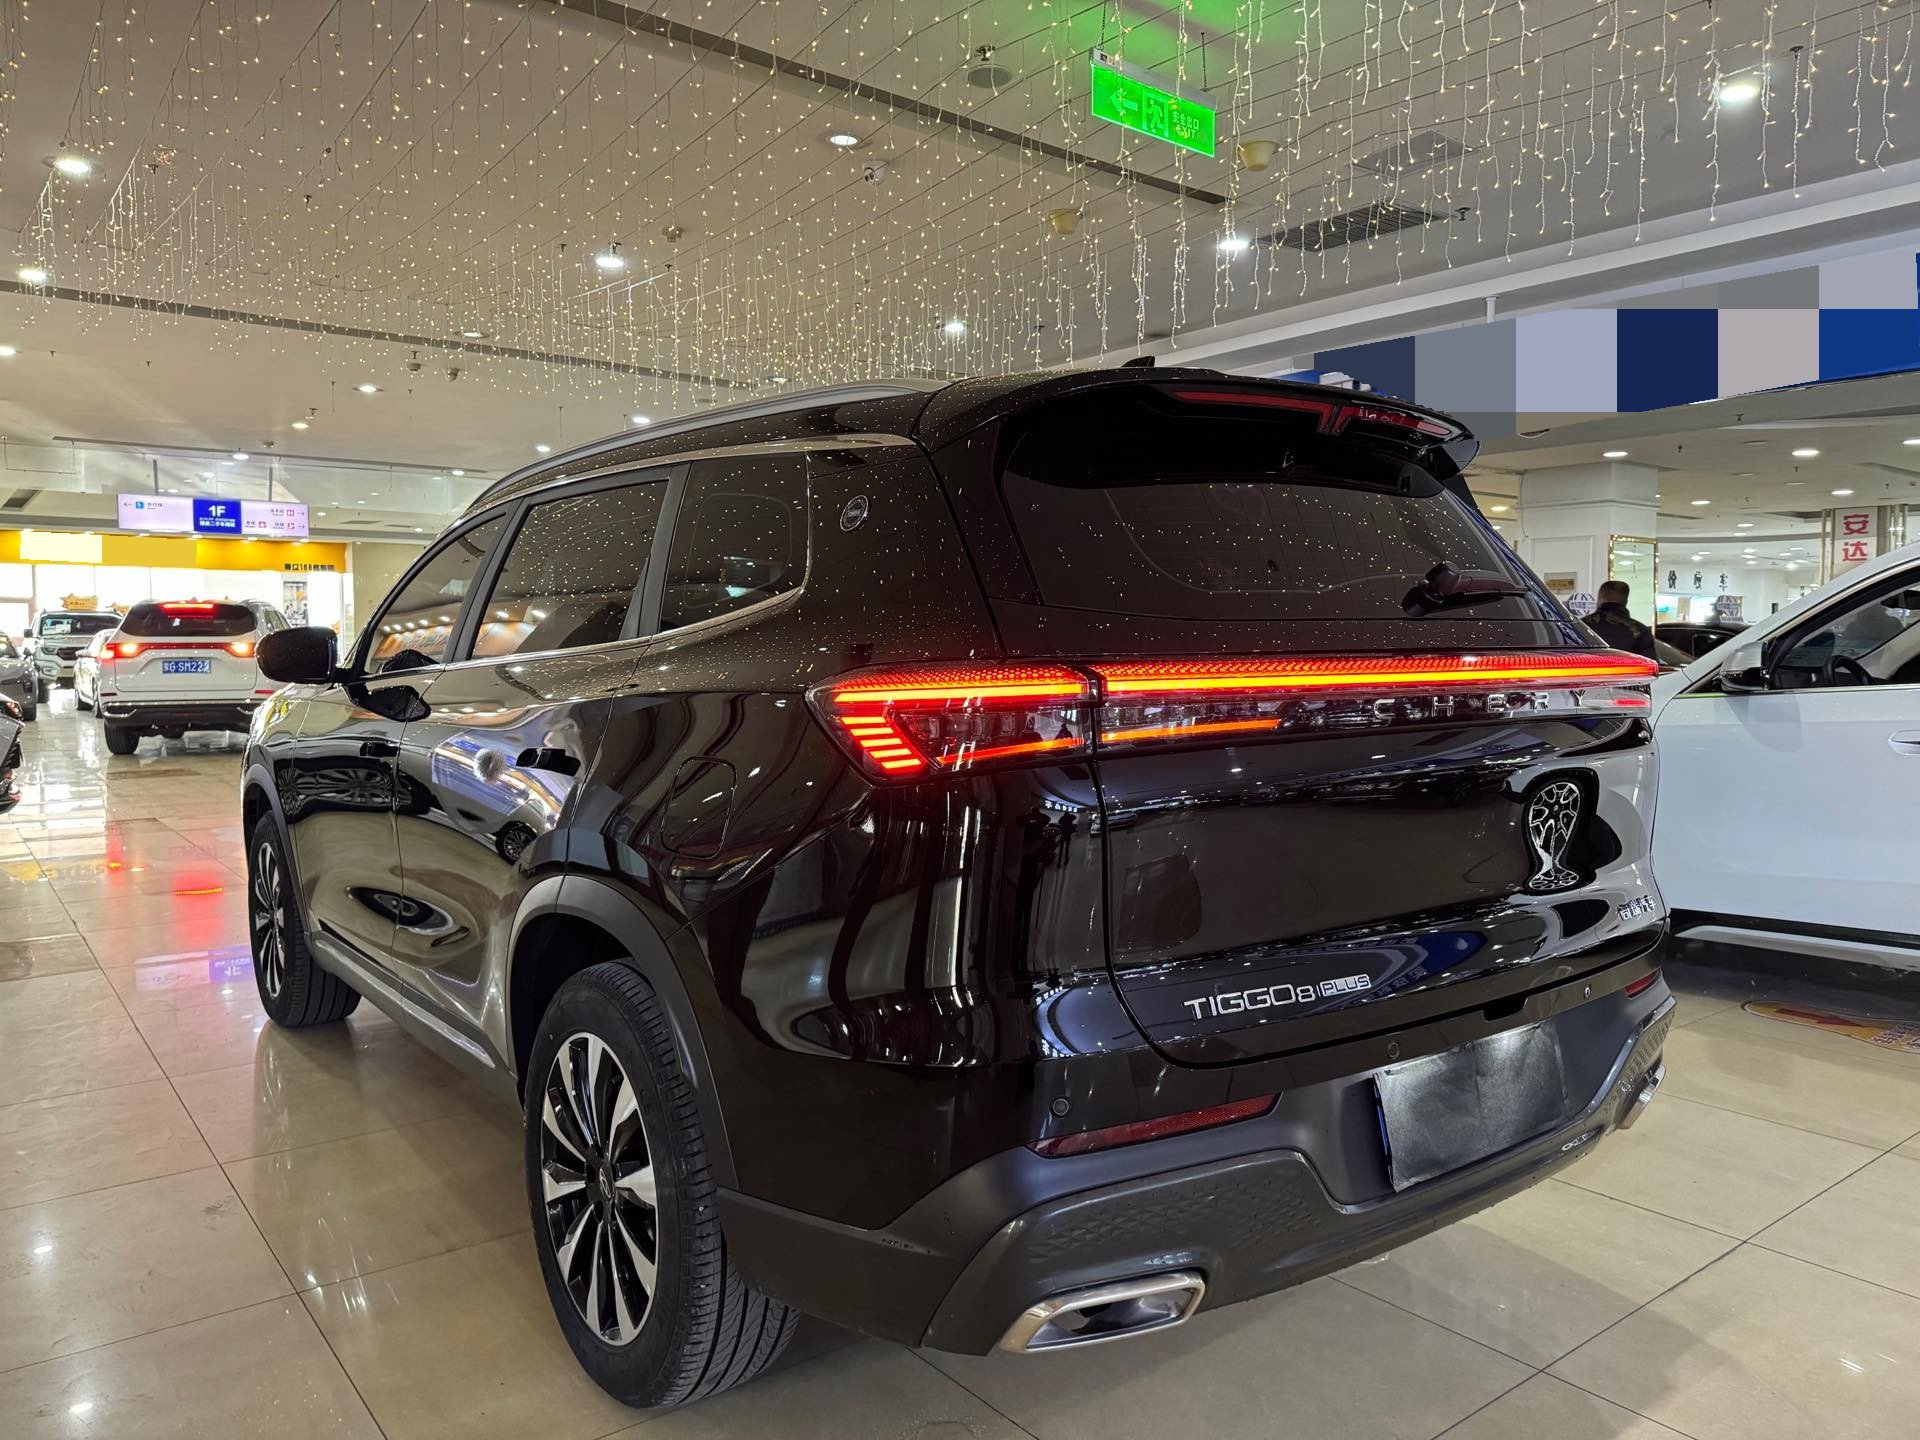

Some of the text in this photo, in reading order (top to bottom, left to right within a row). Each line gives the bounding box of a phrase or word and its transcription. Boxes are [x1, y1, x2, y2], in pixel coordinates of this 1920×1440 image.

[1172, 110, 1199, 130] 安全出口
[208, 505, 226, 517] 1F
[1842, 514, 1869, 562] 安达
[1374, 689, 1587, 719] CHERY
[1321, 974, 1371, 997] PLUS
